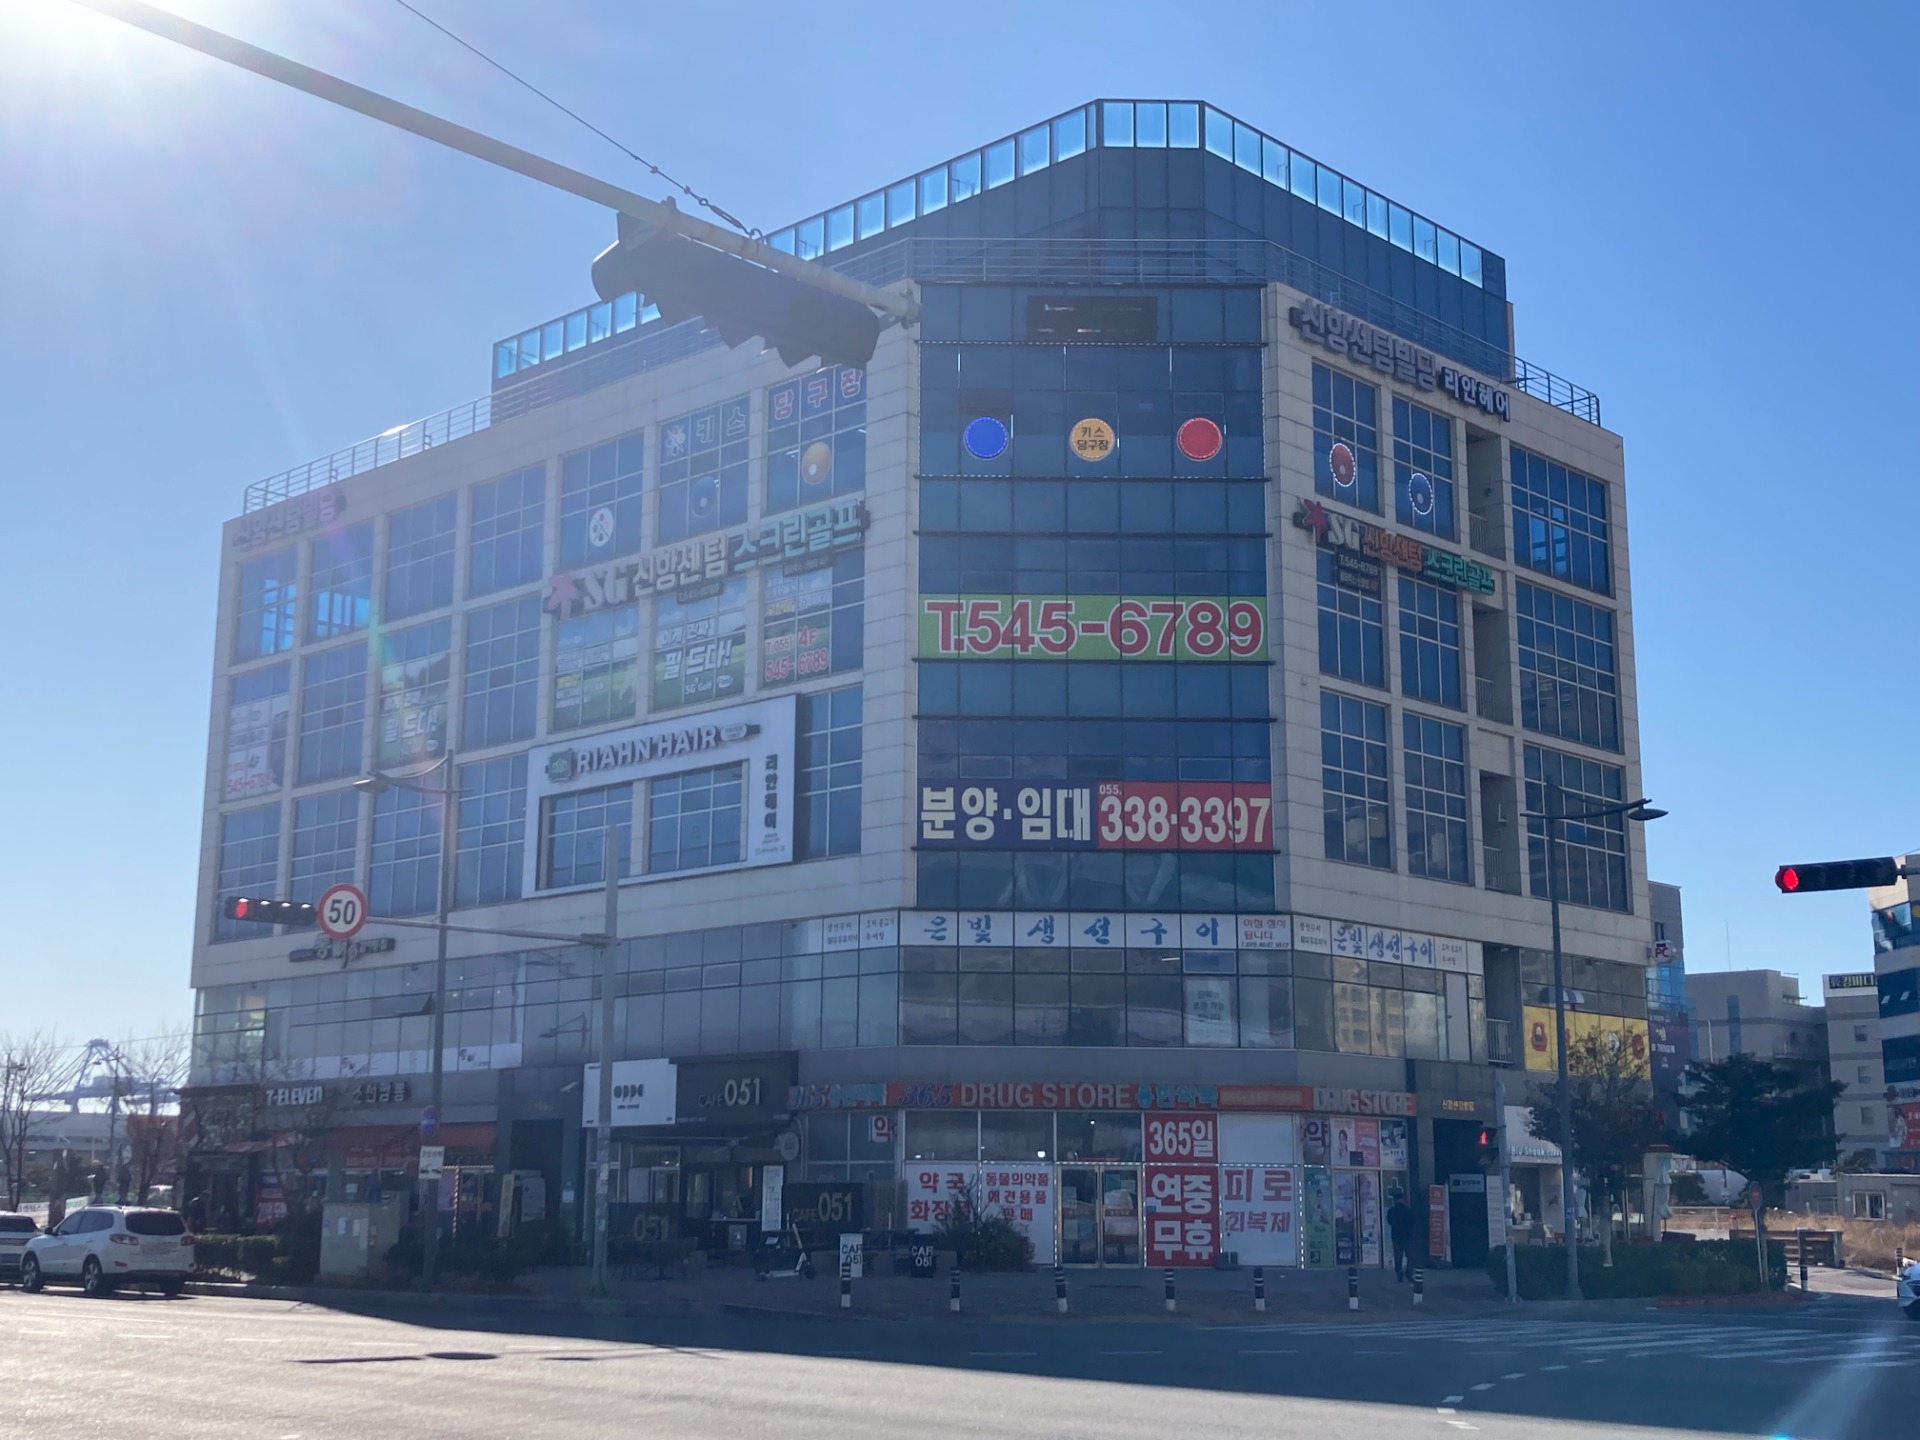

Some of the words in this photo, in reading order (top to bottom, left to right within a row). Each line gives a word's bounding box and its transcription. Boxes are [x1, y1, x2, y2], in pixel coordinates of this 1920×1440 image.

[1300, 297, 1439, 393] 신항센텀빌딩
[1441, 366, 1511, 422] 리안헤어
[774, 368, 863, 421] 당구장
[1077, 438, 1109, 452] 당구장
[1080, 426, 1105, 438] 키스
[632, 534, 728, 597] 신항센텀
[734, 498, 862, 571] 스크린골프
[1361, 523, 1423, 573] 신항센텀
[1423, 547, 1496, 596] 스크린골프
[799, 626, 817, 646] 4F
[924, 599, 1265, 657] T.545-6789
[577, 739, 653, 774] RIAHN
[656, 724, 718, 758] HAIR
[328, 899, 357, 925] 50
[697, 1094, 723, 1108] CAFE
[724, 1078, 761, 1107] 051
[960, 1082, 1035, 1107] DRUG
[1041, 1082, 1132, 1108] STORE
[1312, 1087, 1359, 1113] DRUG
[1359, 1089, 1413, 1115] STORE
[1149, 1120, 1214, 1158] 365일
[986, 1172, 1050, 1188] 동물의약품
[1147, 1173, 1213, 1215] 연중
[1225, 1168, 1292, 1203] 피로
[817, 1191, 853, 1222] 051
[1225, 1211, 1291, 1233] 회복제
[1153, 1219, 1214, 1261] 무휴
